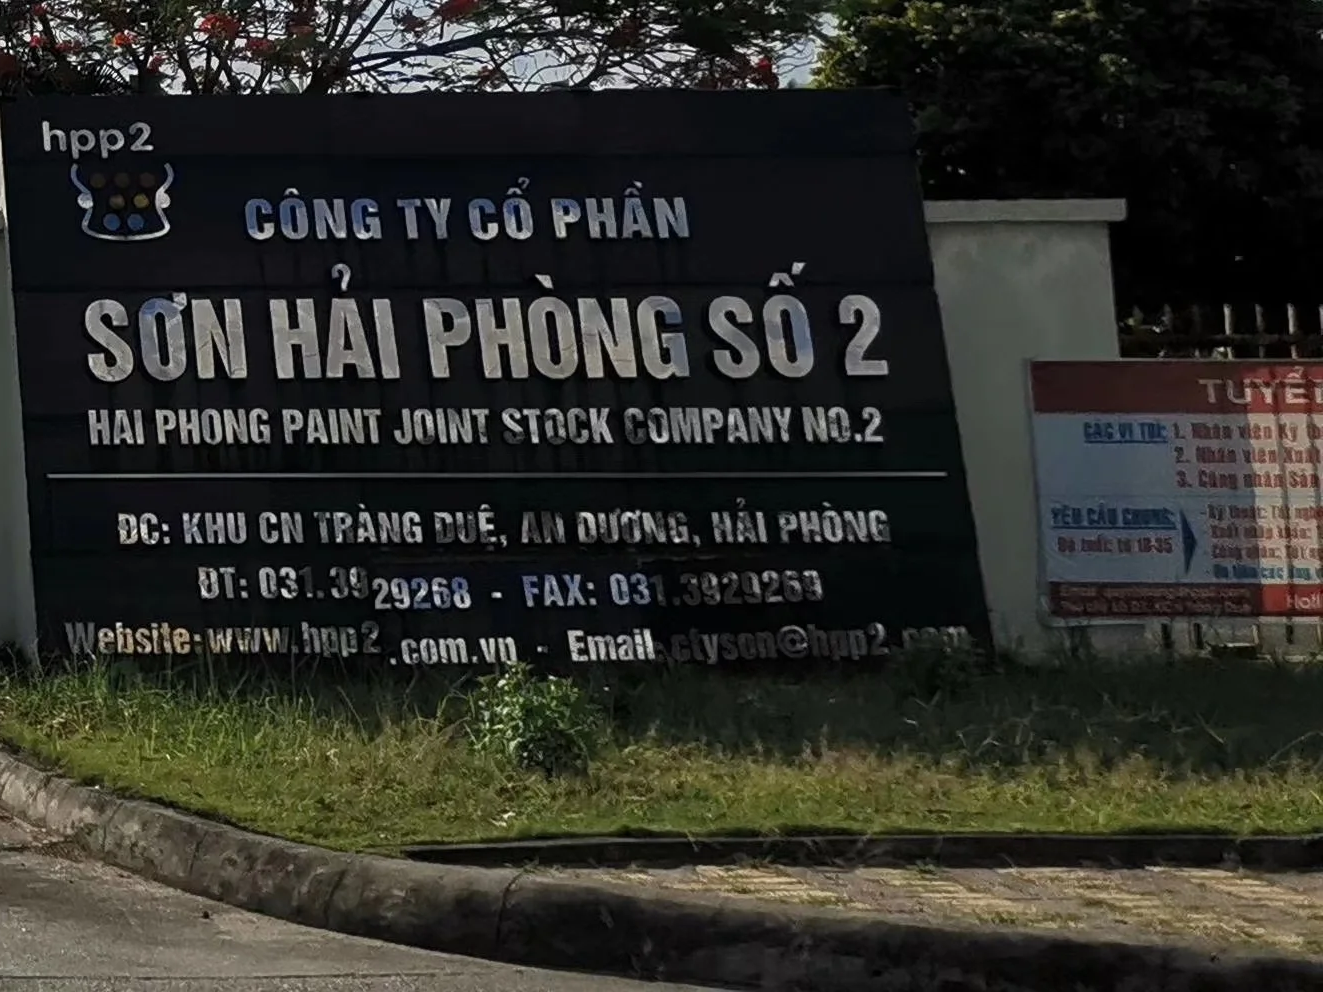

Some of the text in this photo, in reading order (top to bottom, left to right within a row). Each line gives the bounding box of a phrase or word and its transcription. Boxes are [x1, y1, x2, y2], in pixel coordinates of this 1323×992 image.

[41, 120, 154, 160] hpp2
[243, 176, 690, 241] CÔNG TY CỔ PHẦN
[83, 261, 890, 383] SƠN HẢI PHÒNG SỐ 2
[88, 405, 885, 446] HAI PHONG PAINT JOINT STOCK COMPANY NO.2
[182, 511, 248, 545] KHU
[258, 511, 305, 544] CN
[313, 503, 424, 545] TRÀNG
[521, 511, 565, 545] AN
[711, 497, 769, 545] HẢI
[778, 501, 892, 545] PHÒNG
[521, 574, 597, 608] FAX:
